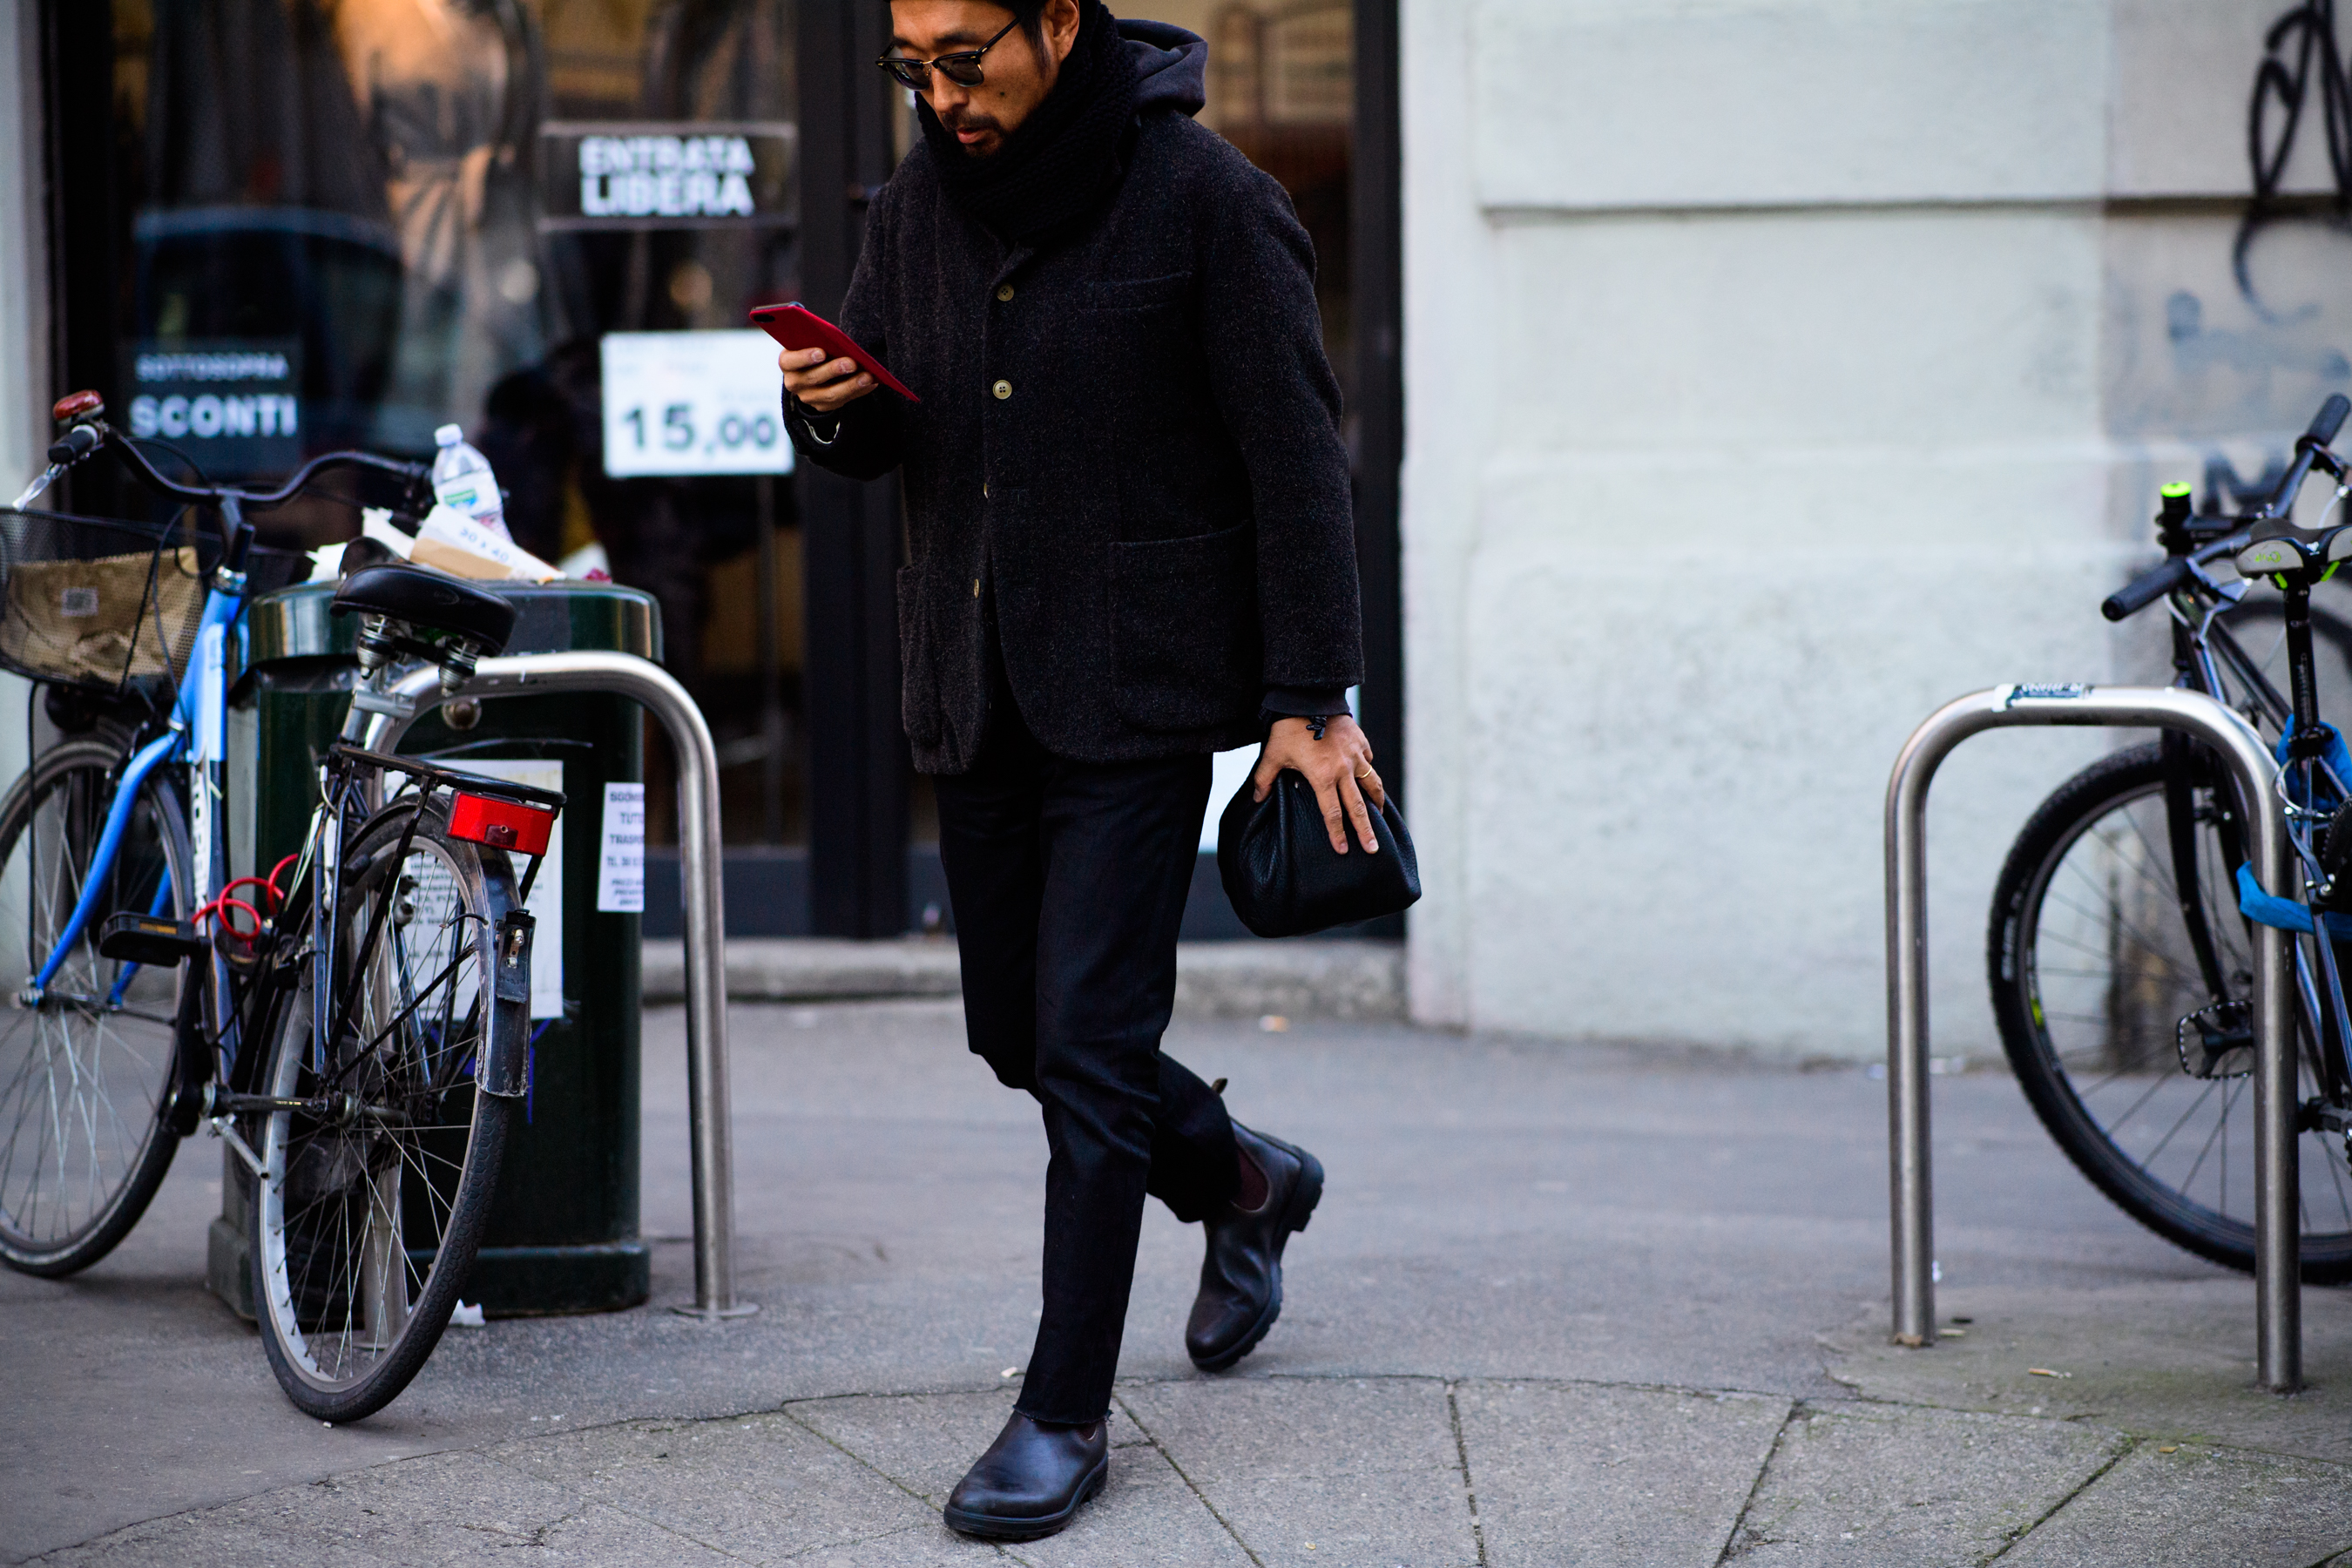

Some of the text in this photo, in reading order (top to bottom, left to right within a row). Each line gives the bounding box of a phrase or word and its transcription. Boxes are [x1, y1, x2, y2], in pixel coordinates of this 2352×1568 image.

[578, 136, 755, 175] ENTRATA
[580, 172, 755, 216] LIBERA
[130, 394, 298, 438] SCONTI
[622, 402, 777, 459] 15,00
